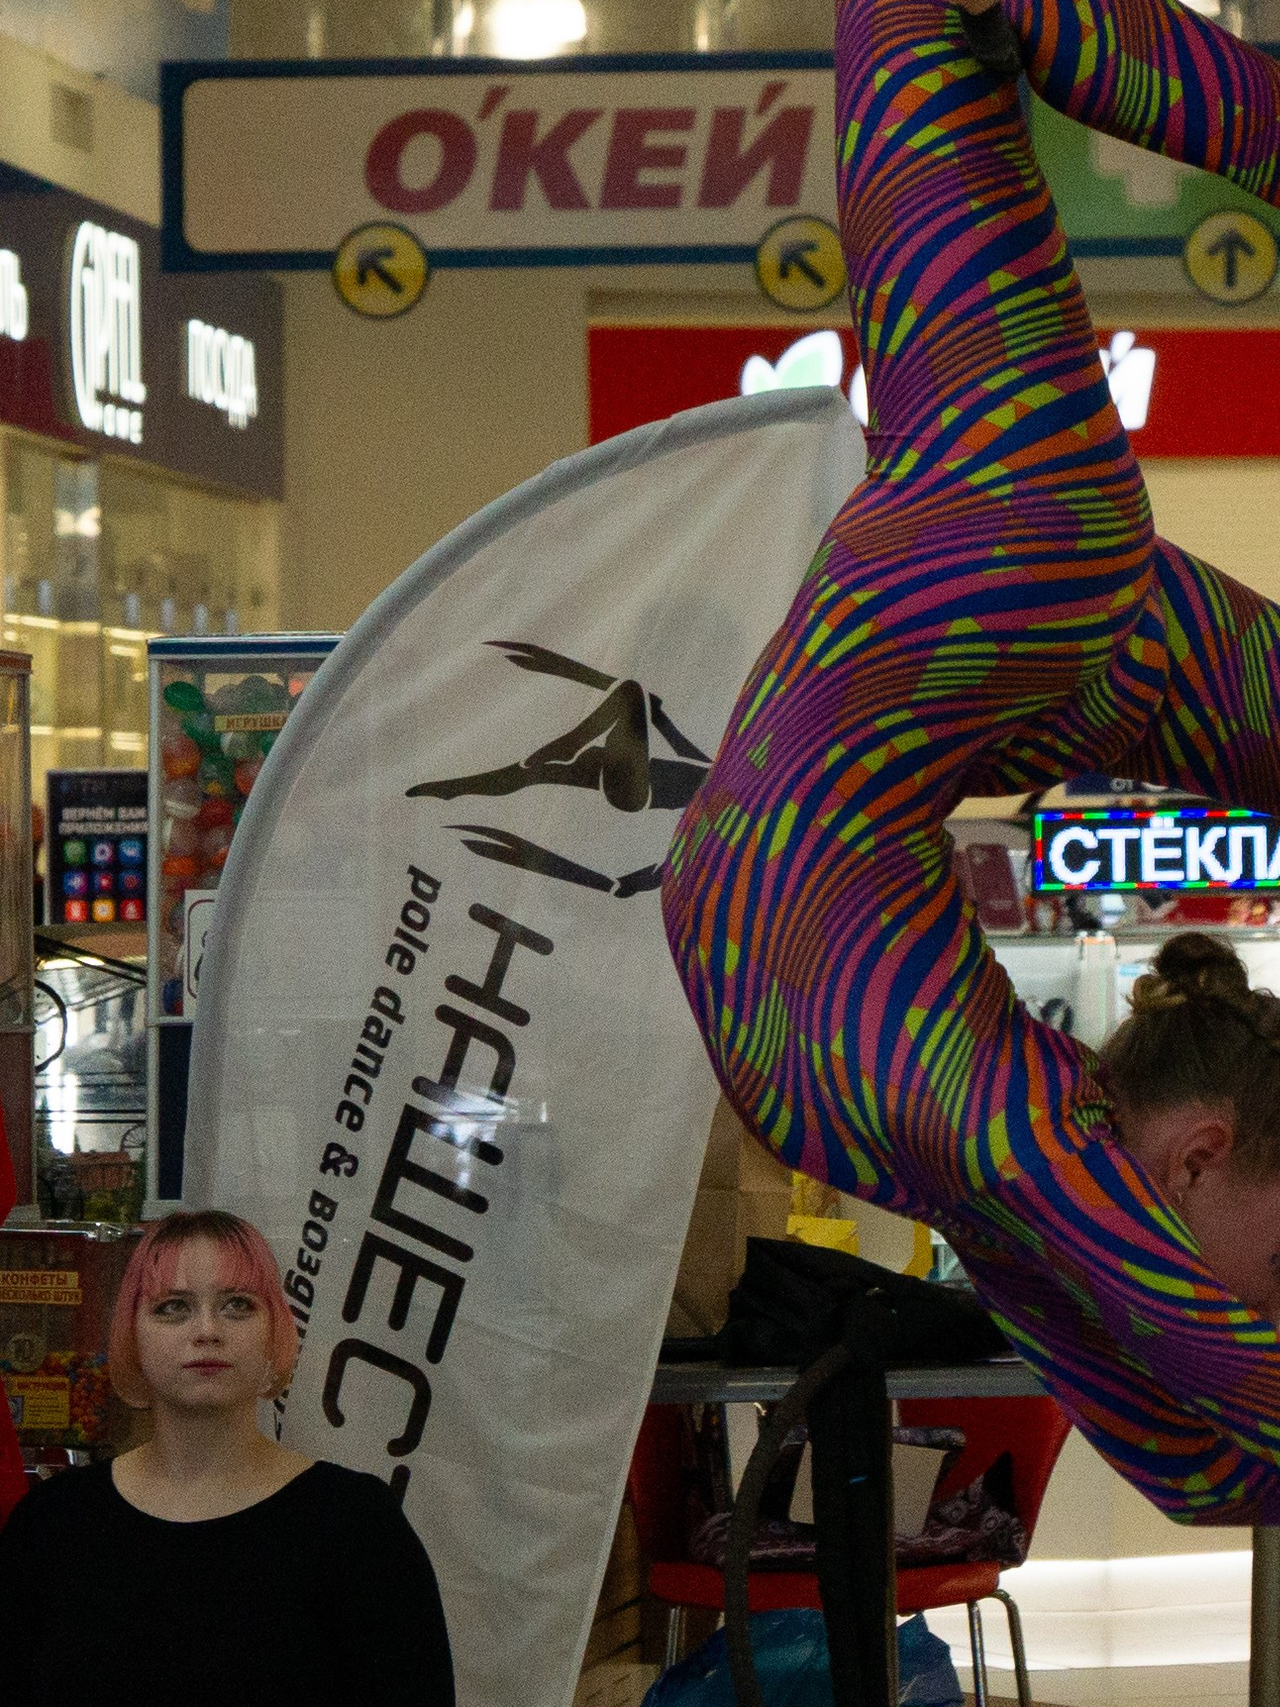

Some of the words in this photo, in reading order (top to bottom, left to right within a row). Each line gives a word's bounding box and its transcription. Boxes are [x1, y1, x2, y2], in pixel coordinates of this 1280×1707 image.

[384, 864, 442, 977] pole
[334, 984, 407, 1134] dance
[319, 1141, 360, 1179] &
[322, 902, 554, 1501] НАШЕС
